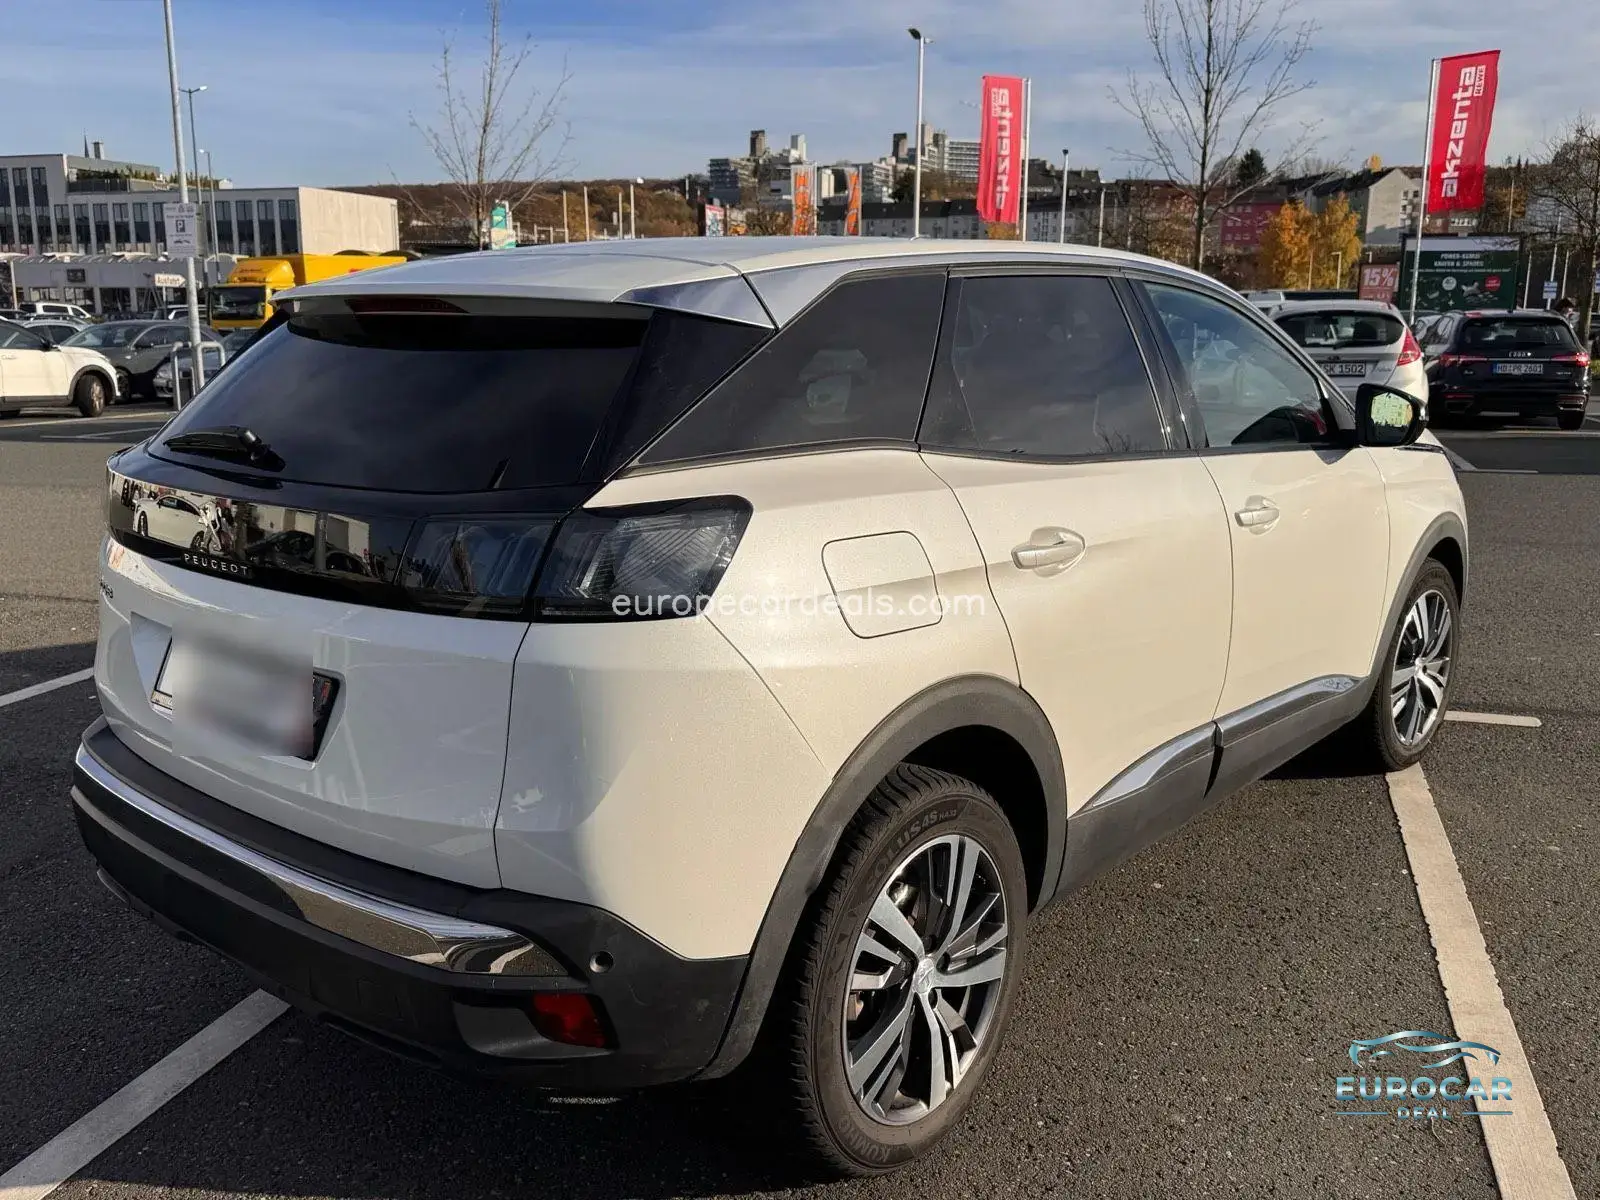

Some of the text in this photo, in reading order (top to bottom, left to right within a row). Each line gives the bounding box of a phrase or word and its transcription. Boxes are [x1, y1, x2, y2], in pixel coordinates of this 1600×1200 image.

[1474, 66, 1486, 96] REWE
[1440, 66, 1476, 198] akzenta
[1363, 267, 1394, 287] 15%
[1338, 363, 1364, 374] 1502
[183, 552, 249, 577] PEUGEOT
